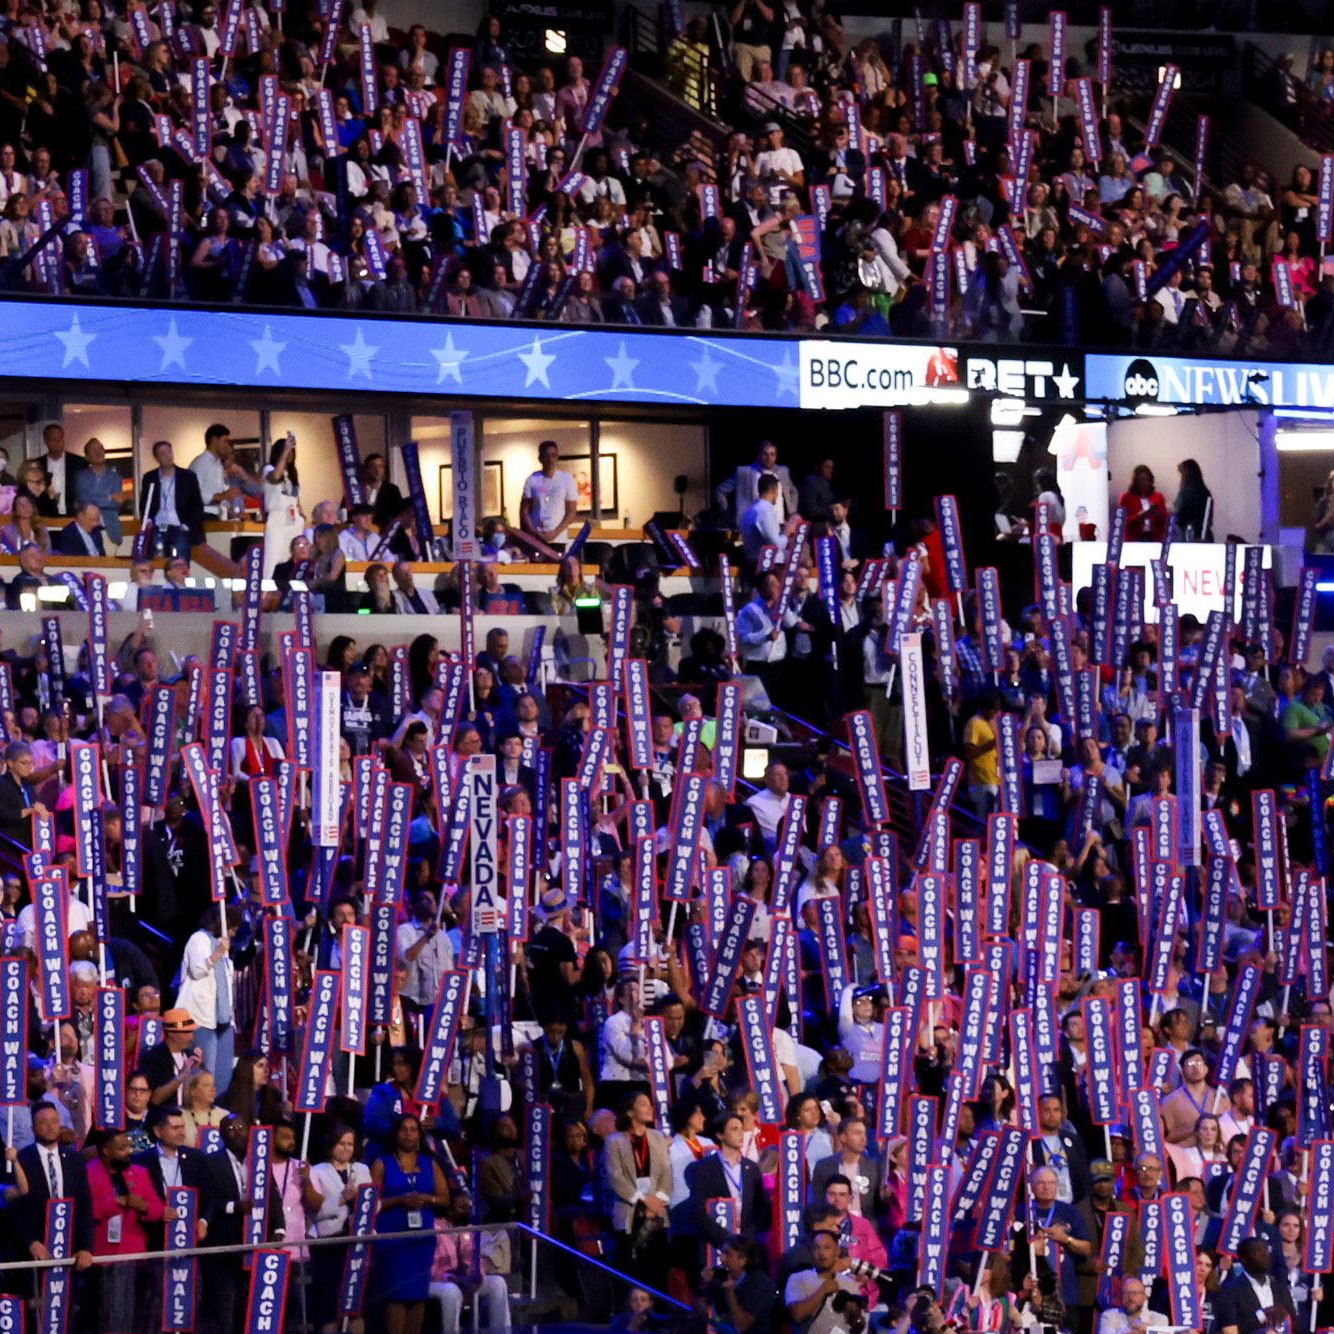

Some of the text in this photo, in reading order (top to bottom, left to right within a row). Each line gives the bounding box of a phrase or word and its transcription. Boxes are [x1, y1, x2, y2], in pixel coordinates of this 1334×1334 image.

[810, 359, 913, 391] BBC.com
[1124, 370, 1158, 398] abc
[1160, 365, 1268, 405] NEWS
[473, 772, 494, 907] NEVADA
[1259, 793, 1274, 904] COACH WALZ
